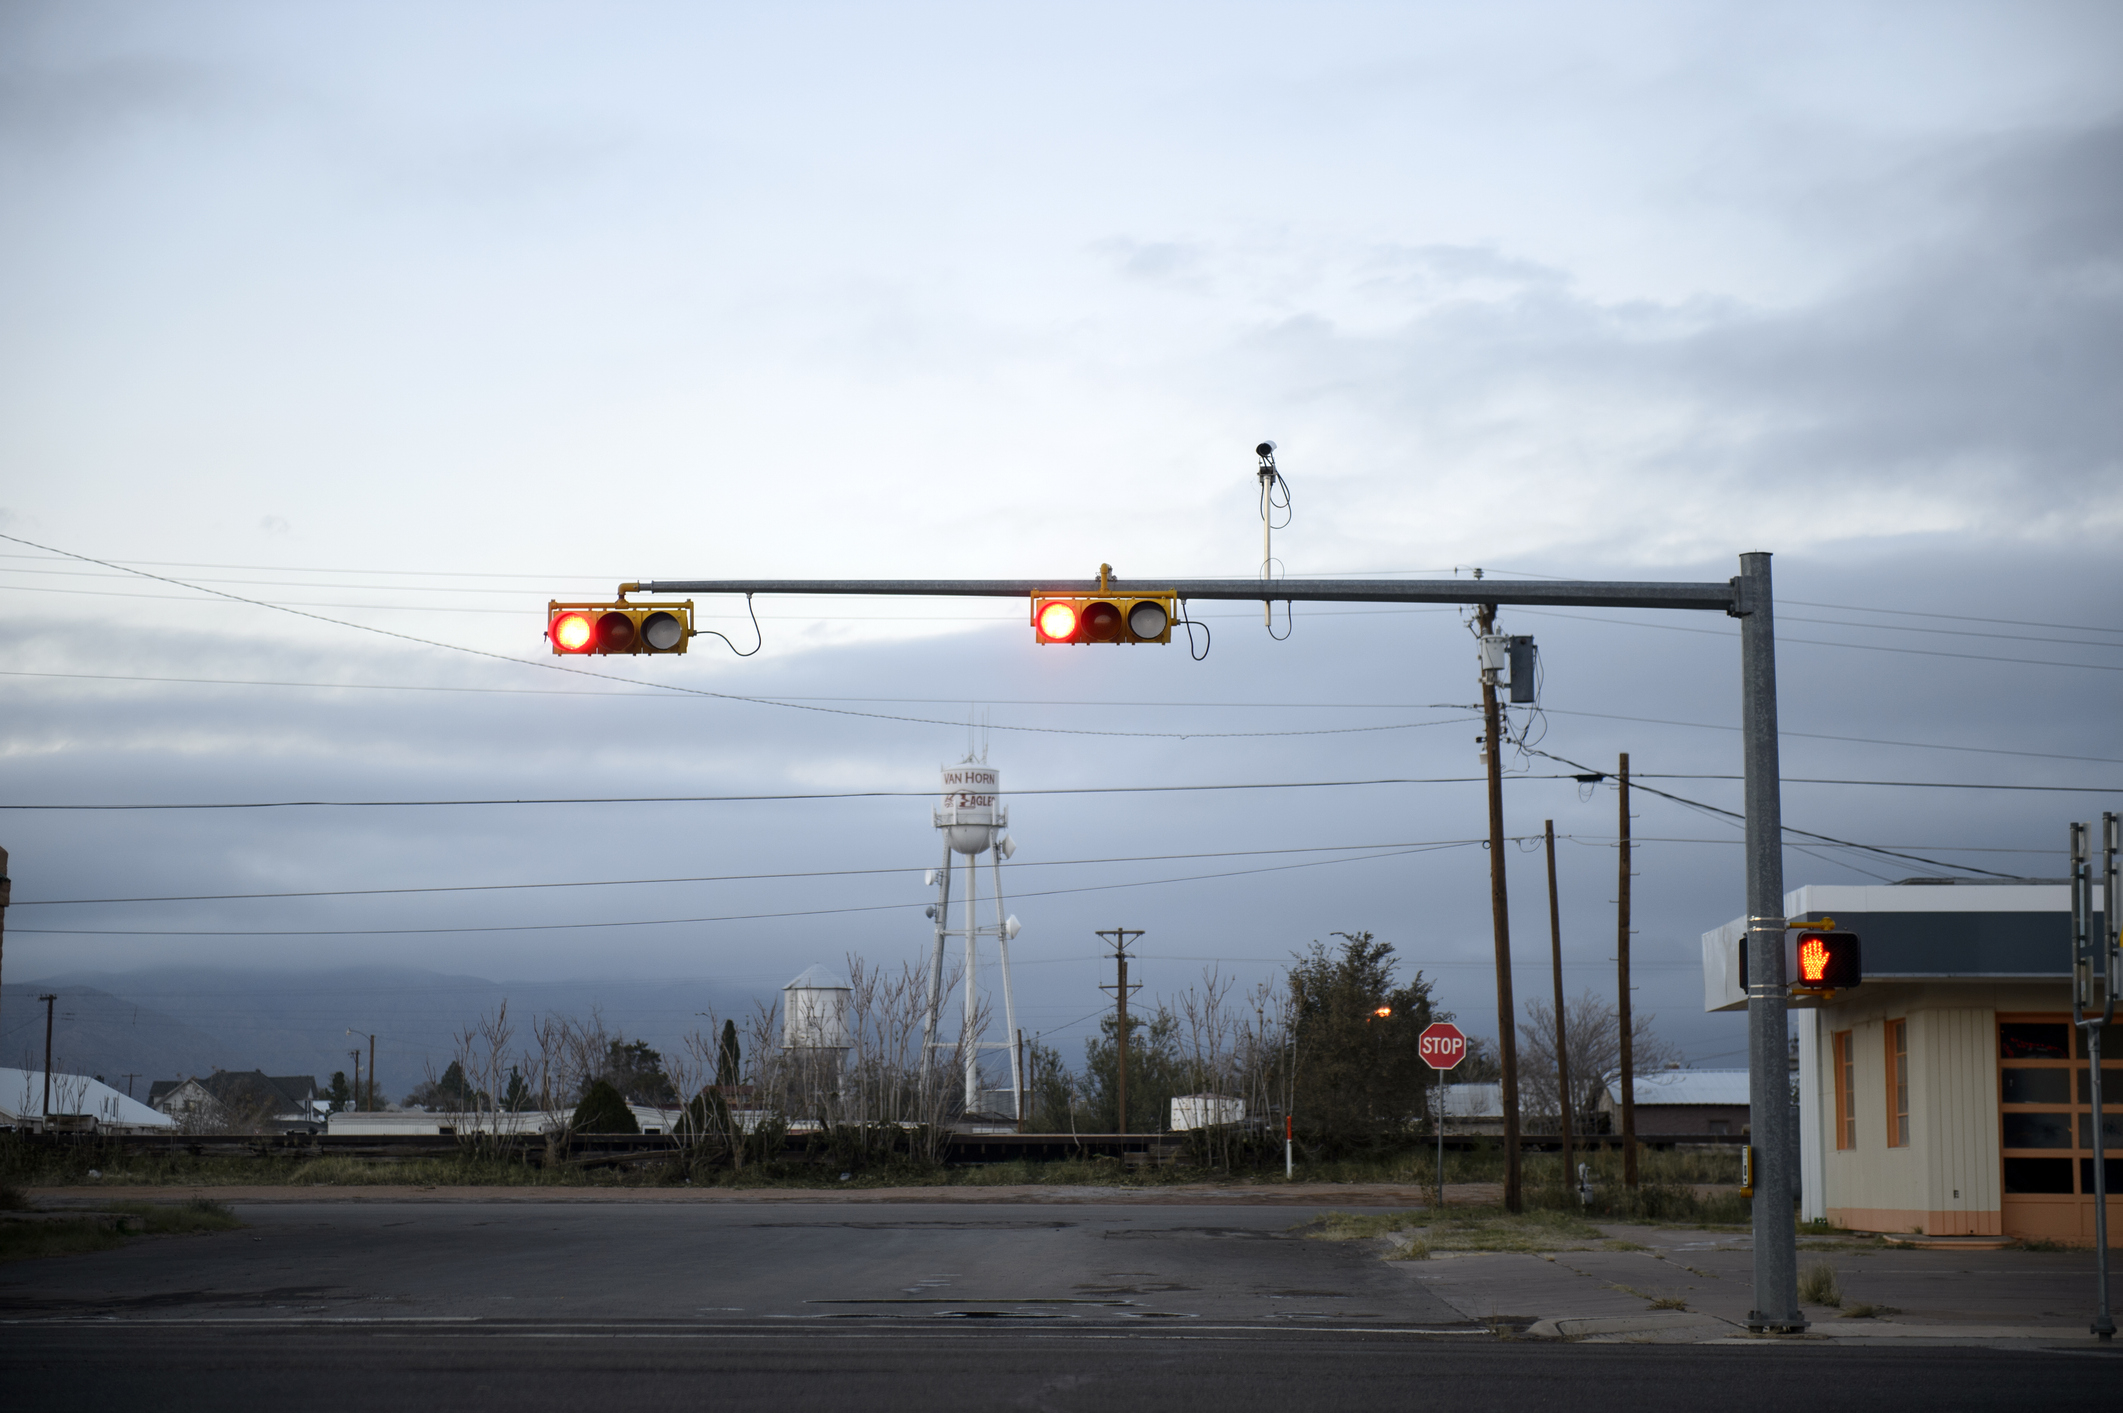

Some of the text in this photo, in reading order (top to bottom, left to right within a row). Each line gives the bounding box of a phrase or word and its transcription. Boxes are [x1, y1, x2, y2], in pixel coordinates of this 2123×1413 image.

[944, 772, 995, 785] VAN HORN
[1422, 1037, 1463, 1054] STOP
